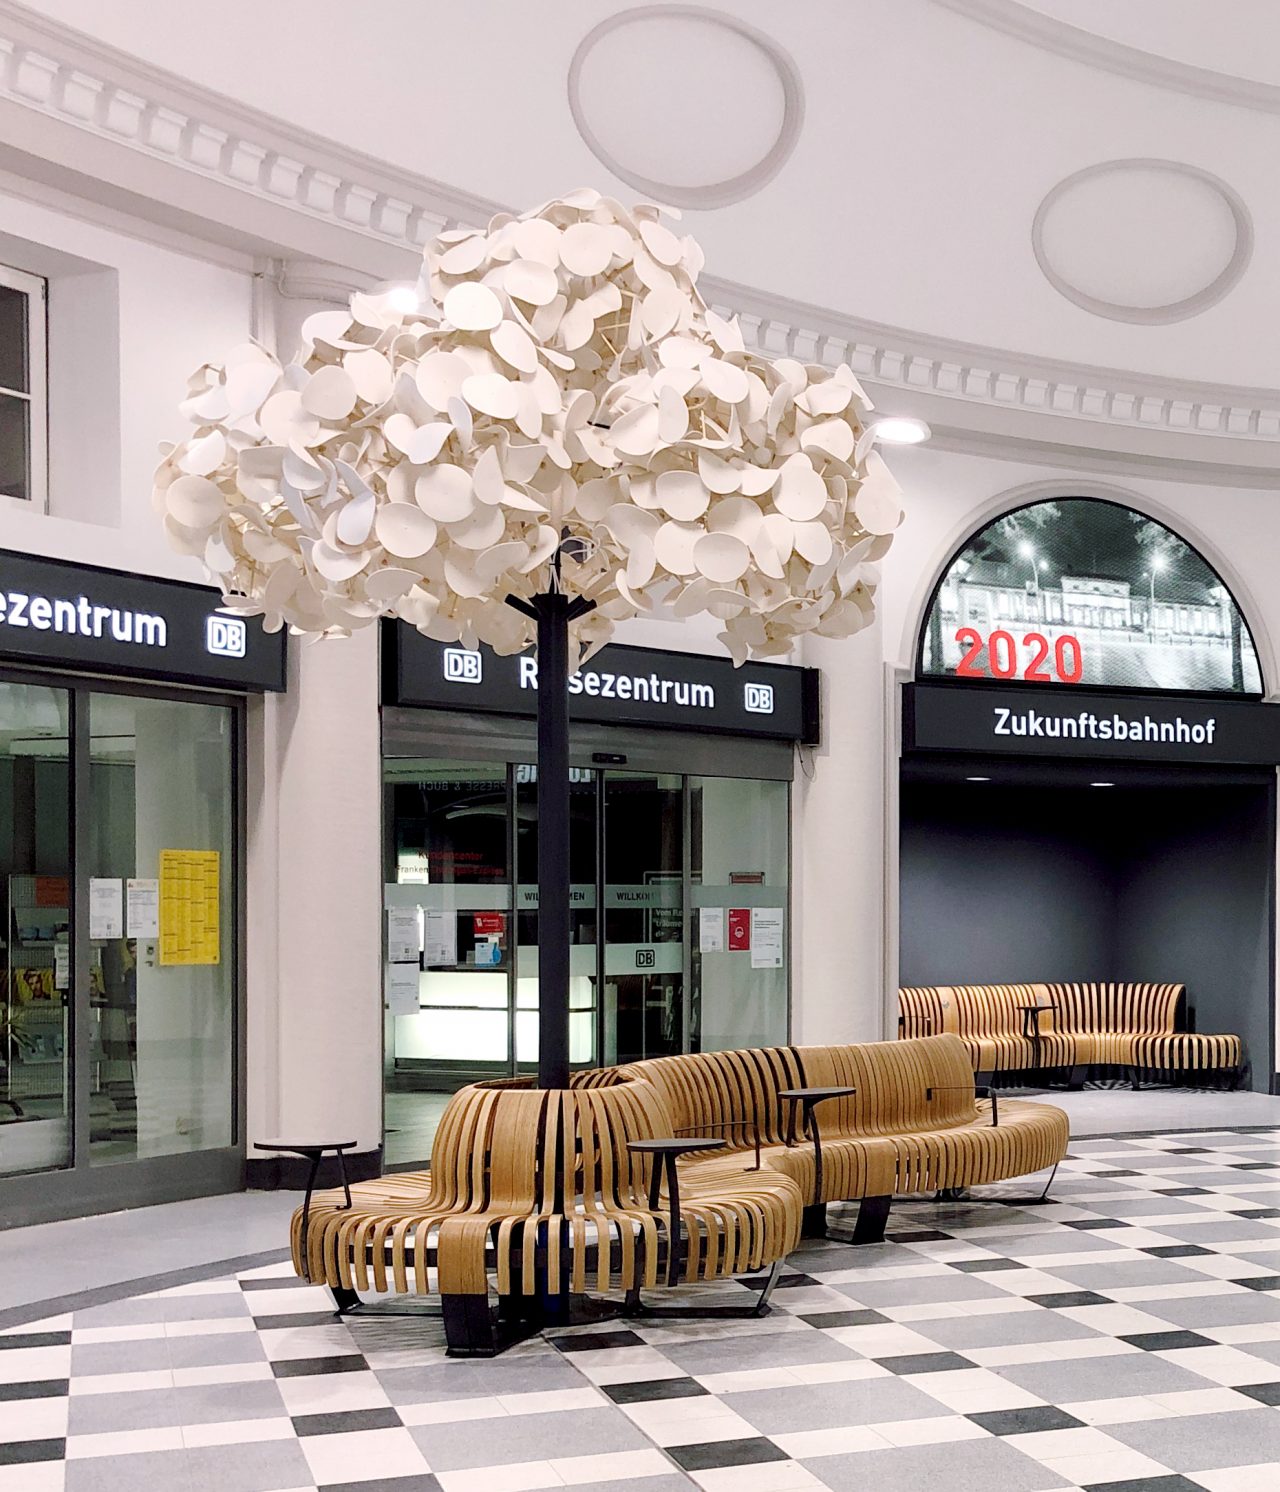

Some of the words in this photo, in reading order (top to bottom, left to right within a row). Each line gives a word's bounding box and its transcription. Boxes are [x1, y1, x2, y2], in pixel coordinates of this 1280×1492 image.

[211, 622, 242, 652] DB
[447, 656, 479, 680] DB
[955, 627, 1083, 683] 2020
[520, 657, 715, 708] Rsezentrum
[748, 688, 772, 710] DB
[994, 708, 1216, 744] Zukunftsbahnhof
